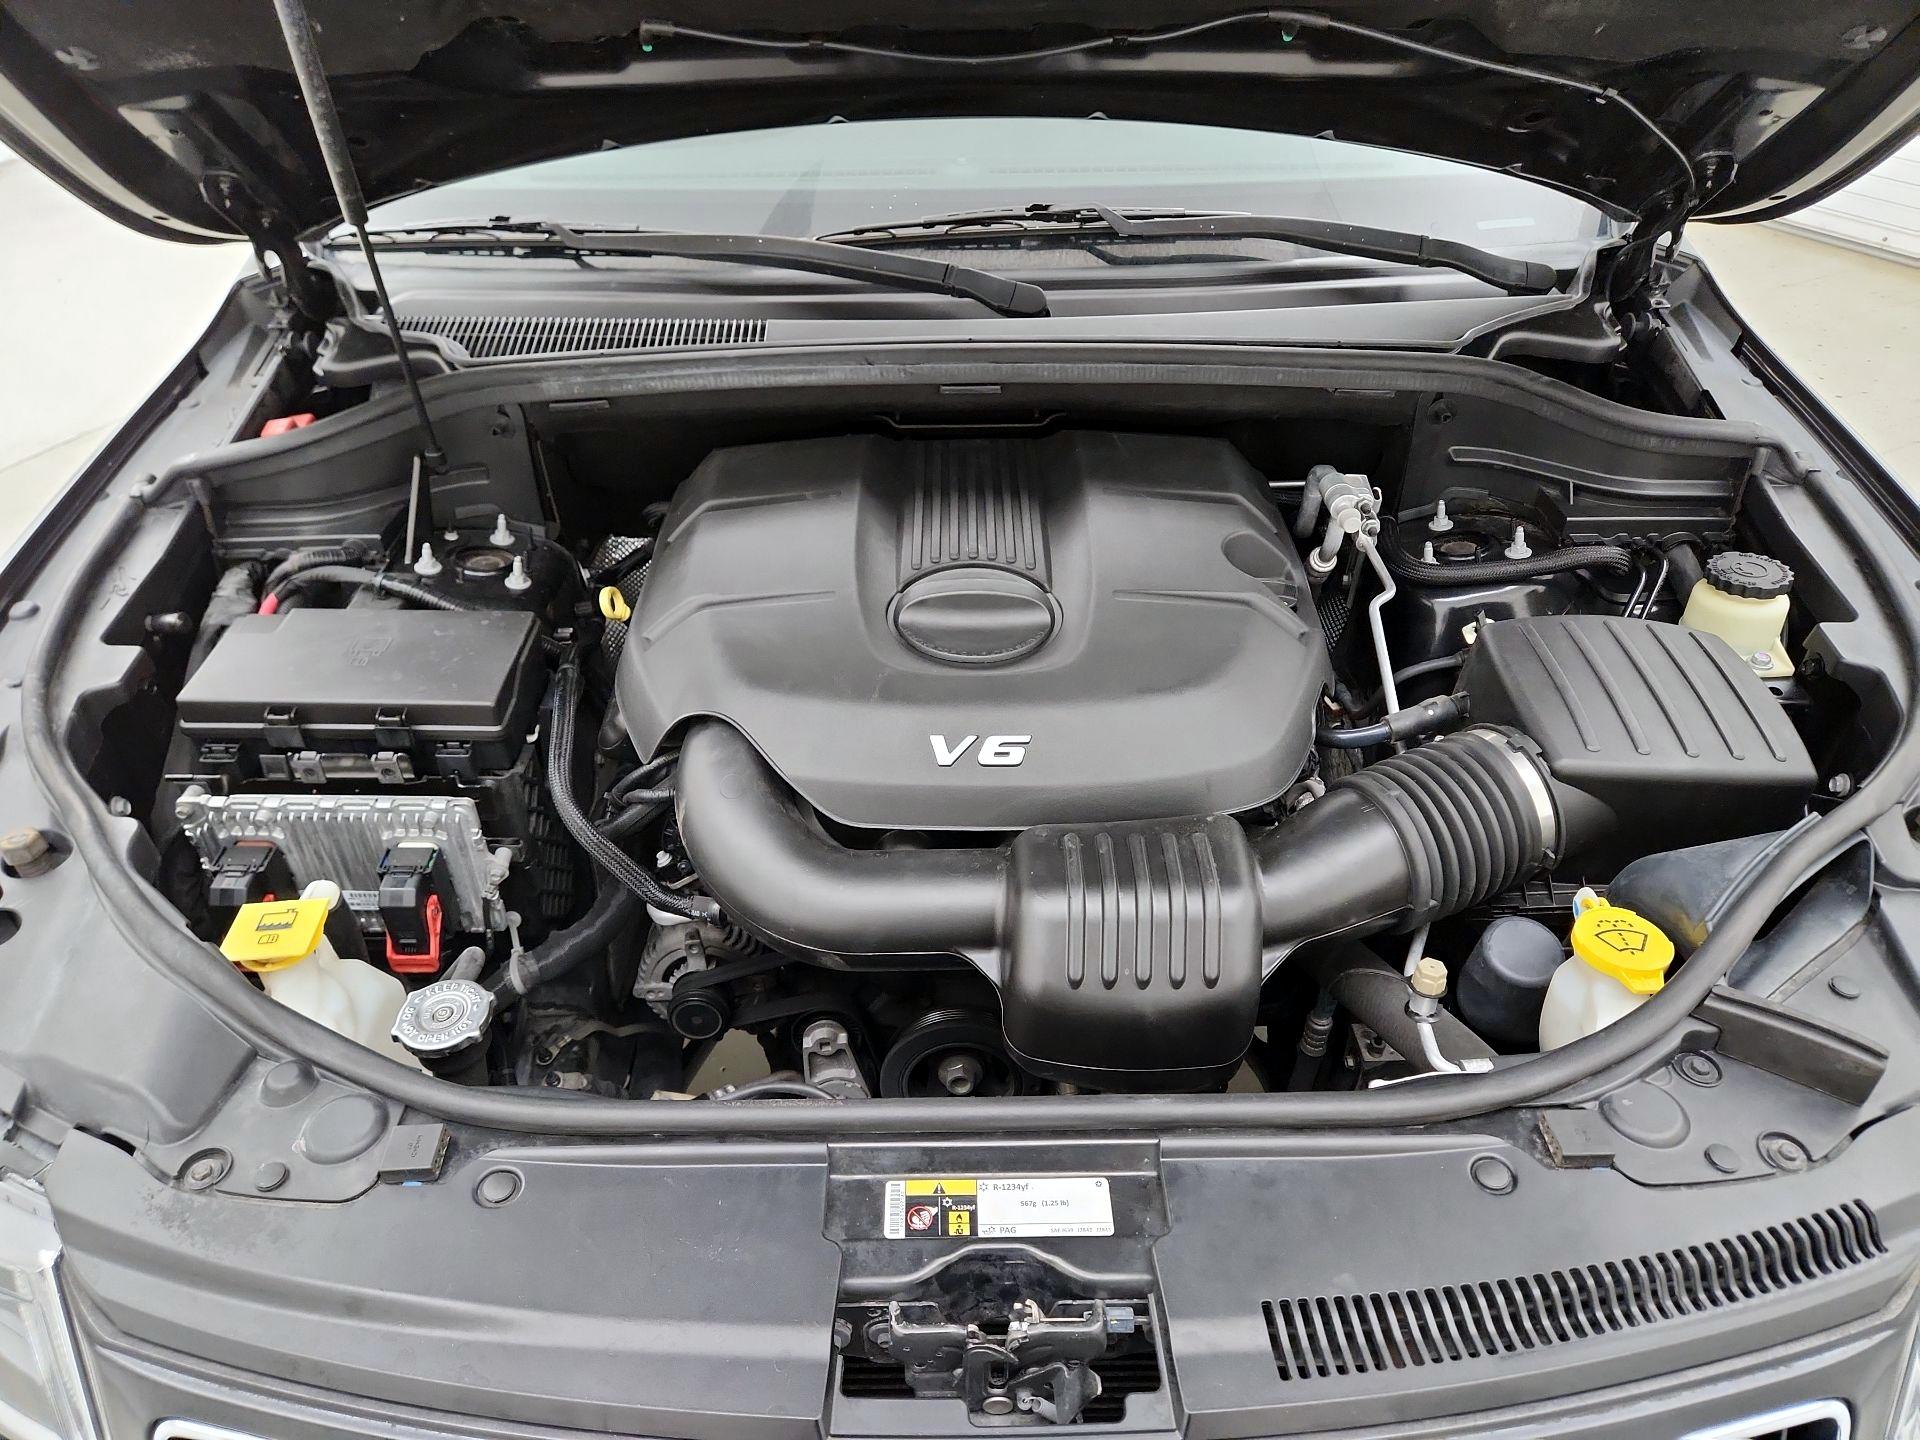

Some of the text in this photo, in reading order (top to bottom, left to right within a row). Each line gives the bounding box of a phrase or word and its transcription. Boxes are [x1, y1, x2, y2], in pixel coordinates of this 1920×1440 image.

[929, 734, 1033, 767] V6
[993, 1183, 1030, 1192] R-1234yf
[1020, 1200, 1037, 1208] 567g
[999, 1226, 1017, 1234] PAG
